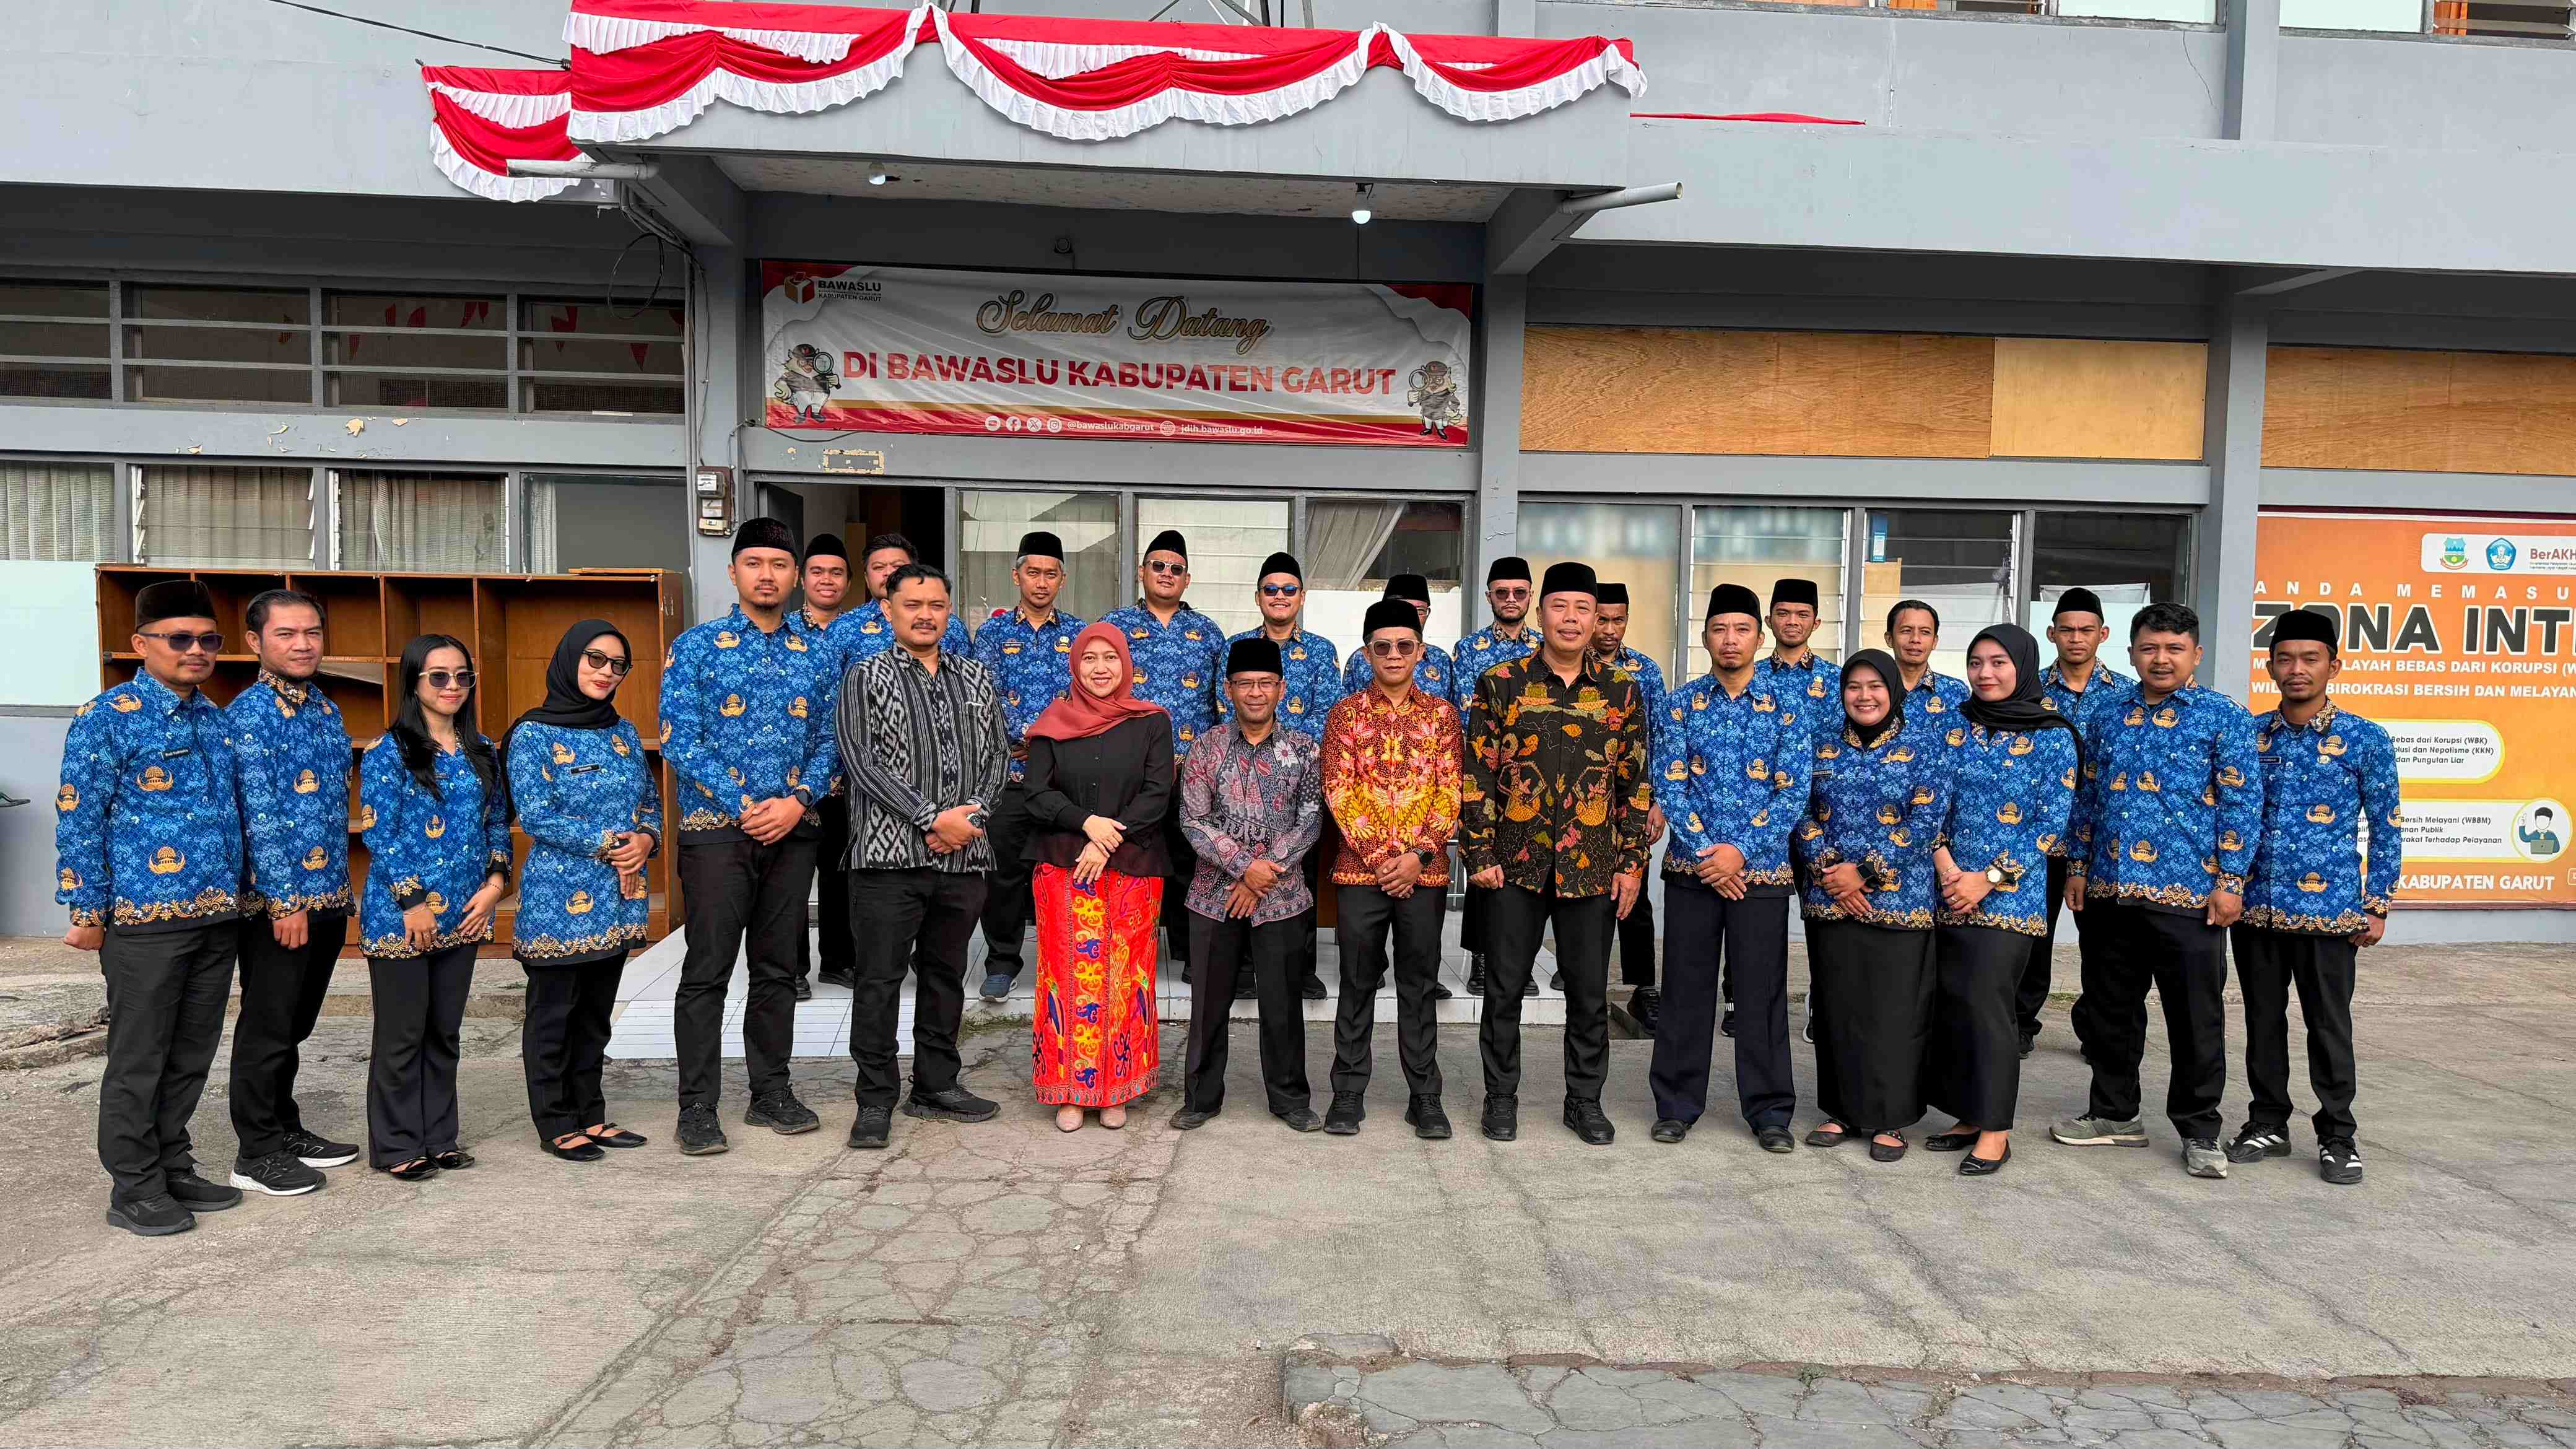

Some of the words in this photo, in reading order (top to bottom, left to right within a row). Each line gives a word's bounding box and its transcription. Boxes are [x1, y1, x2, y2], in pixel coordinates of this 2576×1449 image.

[818, 280, 881, 291] BAWASLU
[977, 289, 1119, 334] Selamat
[1127, 295, 1270, 355] Datang
[843, 351, 877, 379] DI
[887, 353, 1060, 386] BAWASLU
[1068, 360, 1273, 392] KABUPATEN
[1281, 367, 1397, 395] GARUT
[1068, 421, 1155, 432] @bawaslukabgarut
[1181, 424, 1263, 436] jdih.bawaslu.go.id
[2463, 604, 2576, 656] INT
[2342, 659, 2391, 671] LAYAH
[2396, 659, 2446, 672] BEBAS
[2450, 661, 2486, 673] DARI
[2490, 662, 2557, 674] KORUPSI
[2326, 683, 2409, 695] BIROKRASI
[2414, 684, 2470, 697] BERSIH
[2474, 685, 2505, 697] DAN
[2434, 736, 2462, 745] Korupsi
[2464, 737, 2487, 746] (WBK)
[2429, 747, 2469, 755] Nepotisme
[2472, 747, 2494, 755] (KKN)
[2413, 756, 2448, 765] Pungutan
[2426, 816, 2460, 824] Melayani
[2461, 817, 2491, 825] (WBBM)
[2425, 836, 2461, 844] Terhadap
[2463, 837, 2502, 845] Pelayanan
[2398, 874, 2494, 890] KABUPATEN
[2499, 875, 2556, 890] GARUT
